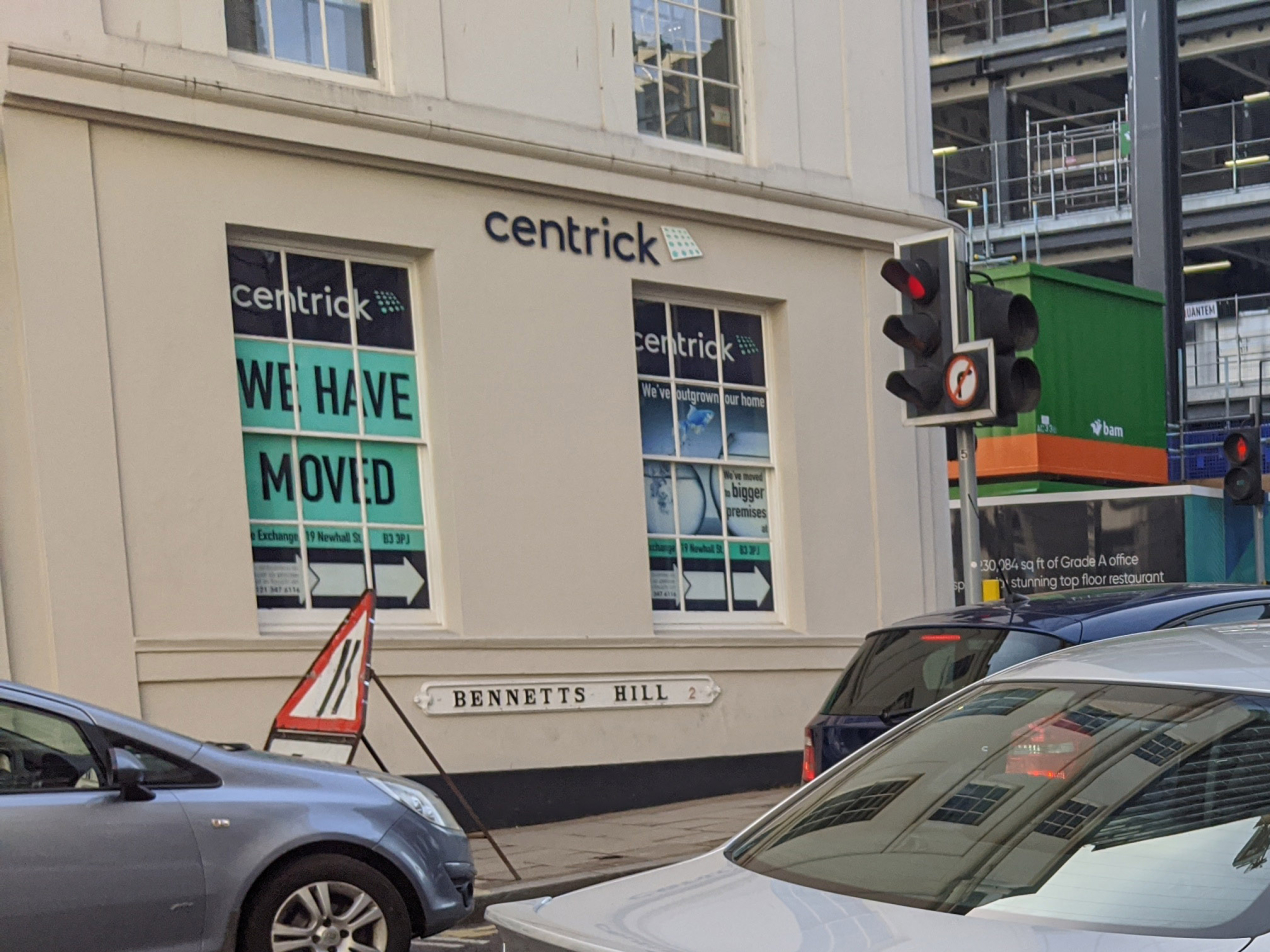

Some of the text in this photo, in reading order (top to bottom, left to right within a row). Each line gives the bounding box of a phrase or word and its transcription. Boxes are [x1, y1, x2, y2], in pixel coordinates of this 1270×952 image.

[484, 210, 661, 266] centrick
[231, 284, 373, 321] centrick
[1186, 304, 1216, 319] UANTEM
[635, 331, 735, 362] centrick
[236, 358, 413, 421] WE HAVE
[641, 382, 765, 408] We've outgrown our home
[1102, 420, 1124, 438] bam
[960, 449, 968, 459] 5
[259, 450, 396, 506] MOVED
[743, 471, 763, 481] moved
[731, 482, 765, 503] bigger
[726, 504, 767, 519] premises
[317, 531, 352, 543] Newhall
[1020, 560, 1035, 573] sq
[1035, 558, 1045, 570] ft
[1046, 556, 1059, 569] of
[1060, 554, 1096, 568] Grade
[1098, 554, 1108, 566] A
[1109, 552, 1140, 566] office
[1011, 571, 1165, 590] stunning top floor restaurant
[452, 684, 697, 708] BENNETTS HILL 2
